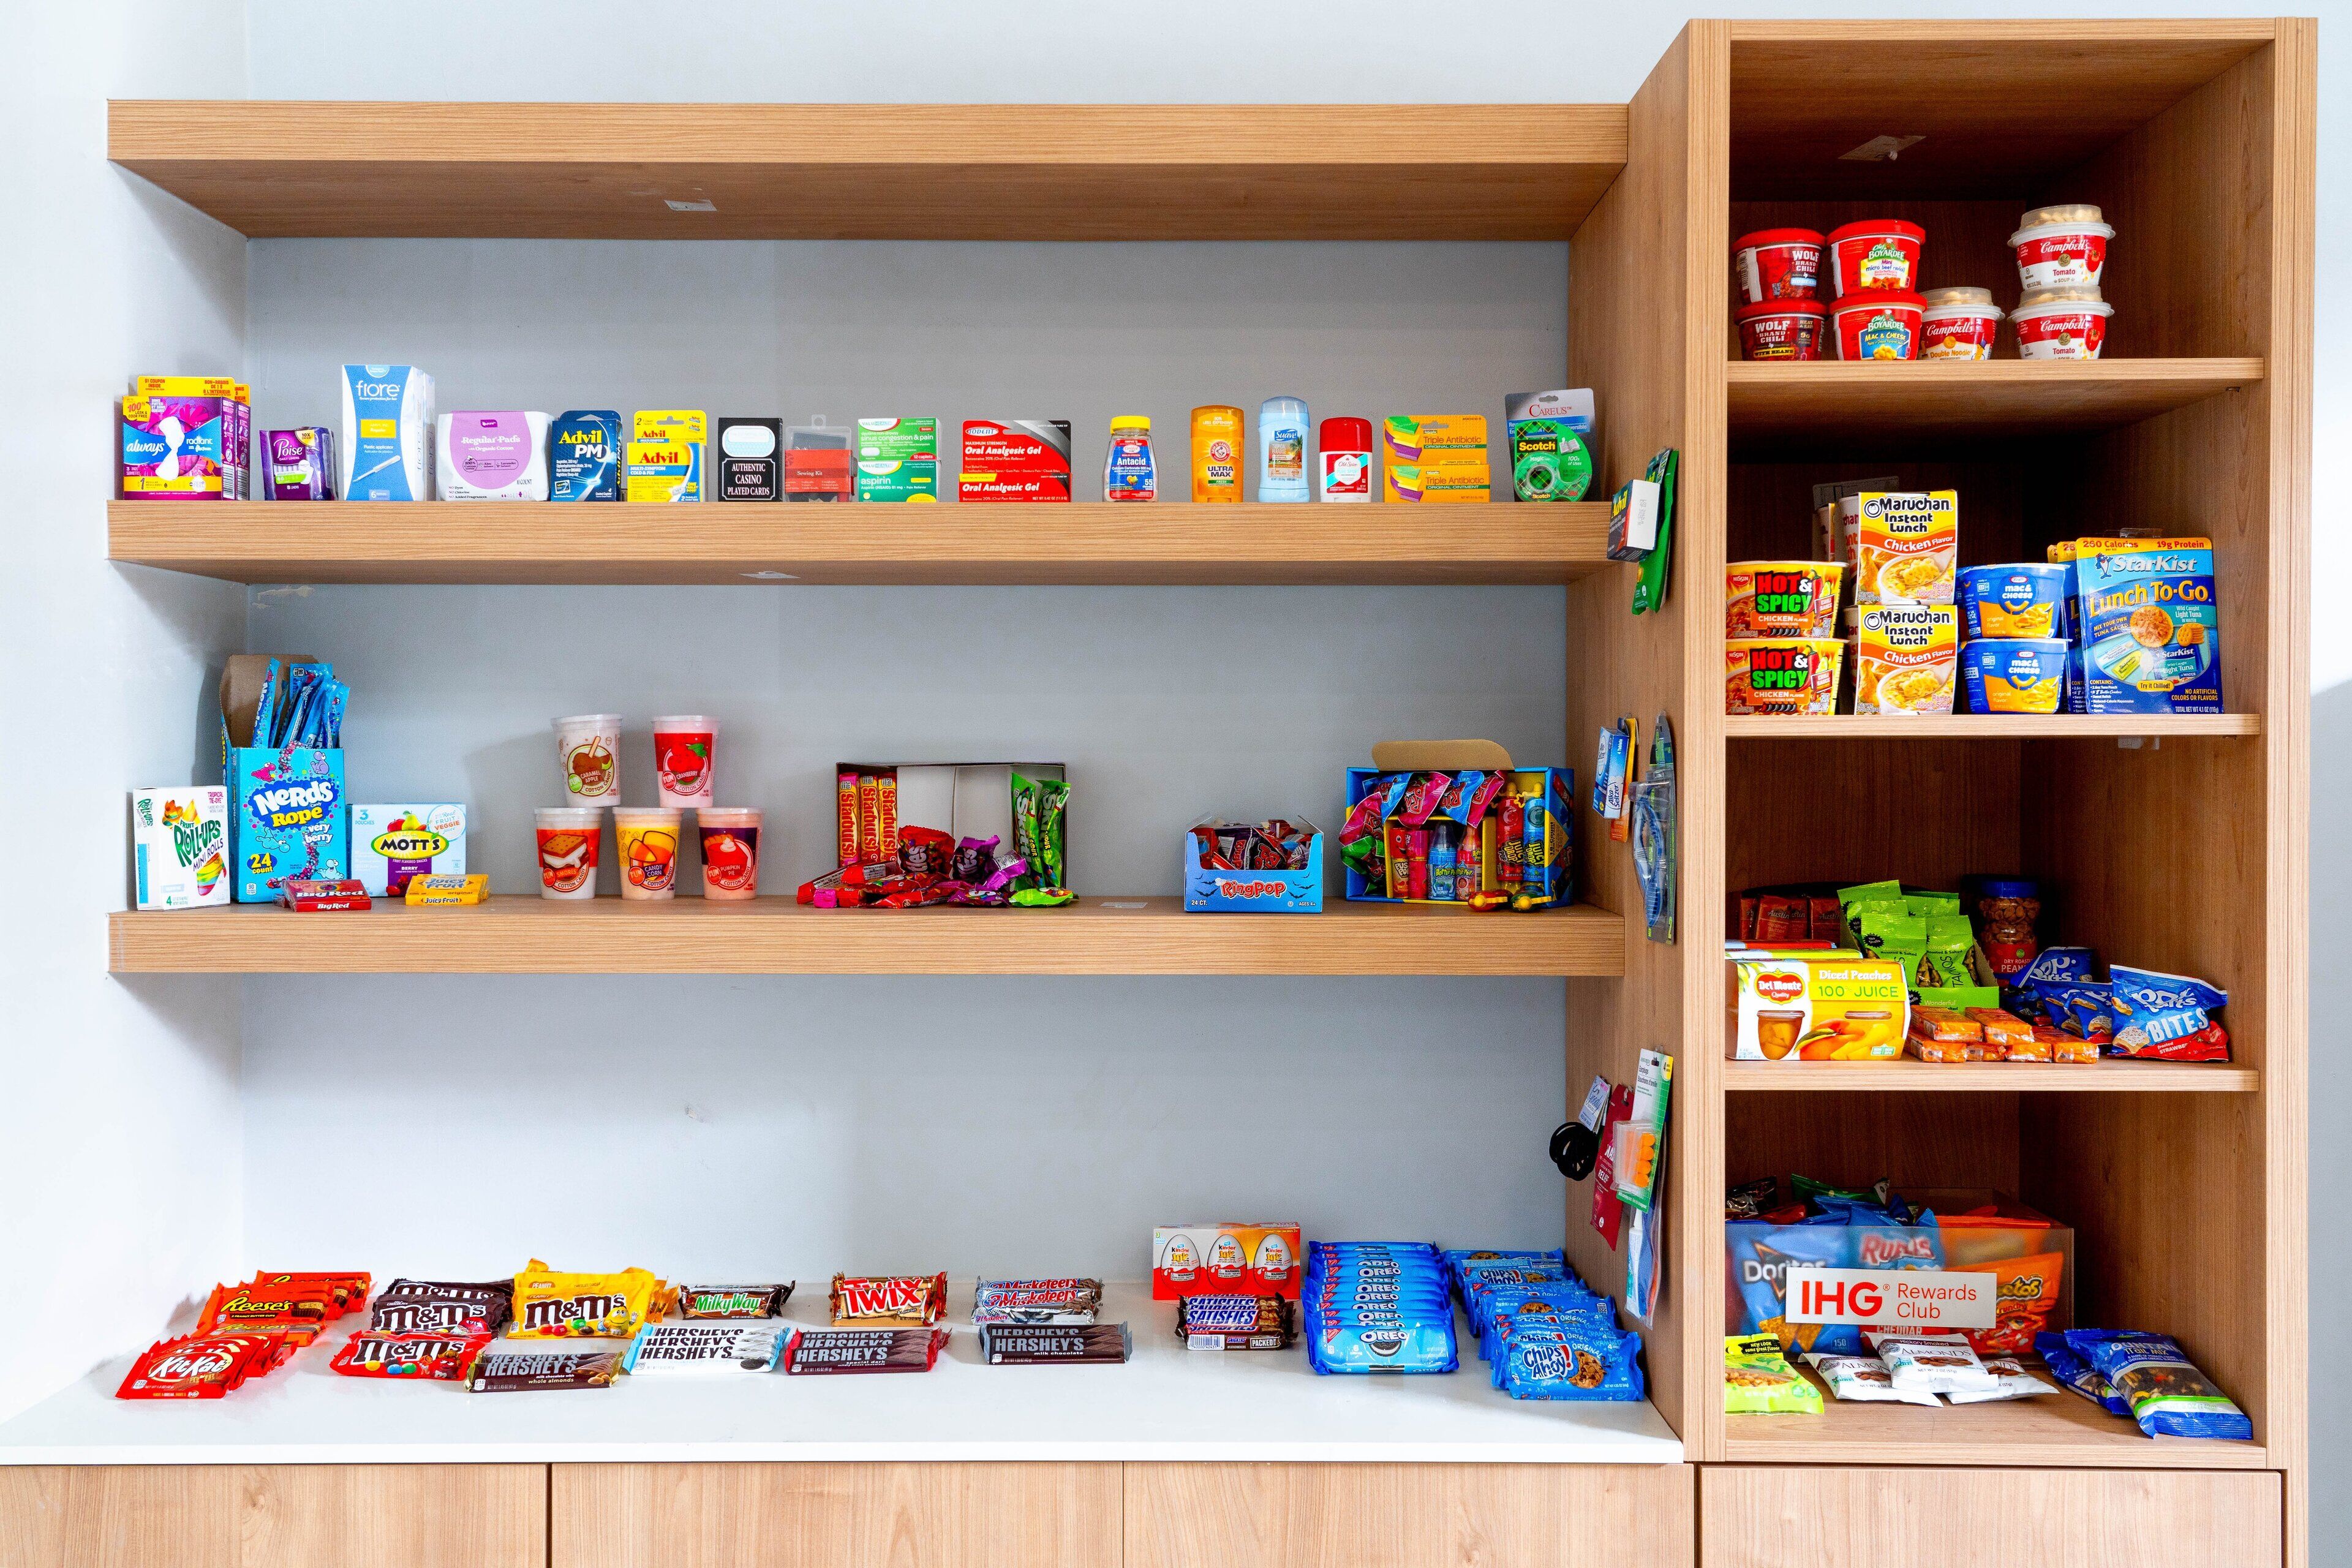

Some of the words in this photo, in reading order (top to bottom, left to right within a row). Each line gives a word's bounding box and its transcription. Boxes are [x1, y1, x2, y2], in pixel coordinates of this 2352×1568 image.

[2041, 239, 2088, 254] Campbell's
[1792, 251, 1819, 260] WOLF
[1869, 250, 1904, 260] BOYARDEE
[1755, 320, 1790, 333] WOLF
[1868, 322, 1904, 331] BOYARDEE
[1928, 323, 1972, 336] Campbell's
[356, 380, 399, 398] fiore
[461, 436, 497, 445] Regular
[559, 431, 601, 444] Advil
[1276, 431, 1296, 440] Suave
[126, 440, 165, 456] always
[274, 439, 303, 458] Poise
[575, 445, 603, 458] PM
[965, 447, 985, 455] Oral
[987, 447, 1023, 456] Analgesic
[1519, 442, 1555, 451] Scotch
[639, 452, 678, 464] Advil
[736, 475, 761, 484] CASINO
[861, 477, 891, 486] aspirin
[728, 487, 748, 496] PLAYED
[750, 487, 769, 496] CARDS
[1879, 499, 1950, 511] Maruchan
[1885, 513, 1932, 522] Instant
[1890, 523, 1927, 532] Lunch
[1885, 538, 1931, 551] Chicken
[1932, 536, 1953, 545] Flavor
[2113, 556, 2196, 573] StarKist
[1757, 575, 1798, 594] HOT
[1798, 579, 1812, 591] &
[1757, 595, 1812, 612] SPICY
[2090, 586, 2148, 616] Lunch
[2151, 579, 2209, 601] To-Go
[1879, 611, 1950, 624] Maruchan
[1885, 626, 1932, 635] Instant
[1890, 636, 1927, 644] Lunch
[1885, 651, 1931, 664] Chicken
[1932, 649, 1953, 658] Flavor
[862, 786, 877, 851] Starburst
[880, 788, 895, 854] Starburst
[840, 793, 856, 861] Starburst
[175, 820, 221, 867] ROLL-UPS
[306, 834, 333, 843] berry
[380, 839, 440, 851] MOTT'S
[251, 854, 271, 867] 24
[1819, 971, 1849, 980] Diced
[1851, 971, 1891, 980] Peaches
[1758, 981, 1772, 990] Del
[1774, 981, 1801, 990] Monte
[1855, 986, 1898, 997] JUICE
[2148, 1008, 2207, 1042] BITES
[1898, 1283, 1977, 1299] Rewards
[221, 1297, 293, 1312] Reese's
[1802, 1281, 1882, 1316] IHG
[1898, 1303, 1940, 1319] Club
[1186, 1311, 1257, 1325] SATISFIES
[1360, 1331, 1408, 1341] OREO
[996, 1338, 1084, 1352] HERSHEY'S
[1572, 1344, 1601, 1359] ORIGINAL
[640, 1347, 731, 1360] HERSHEY'S
[796, 1348, 888, 1362] HERSHEY'S
[1523, 1344, 1561, 1368] Chips
[485, 1360, 576, 1376] HERSHEY'S
